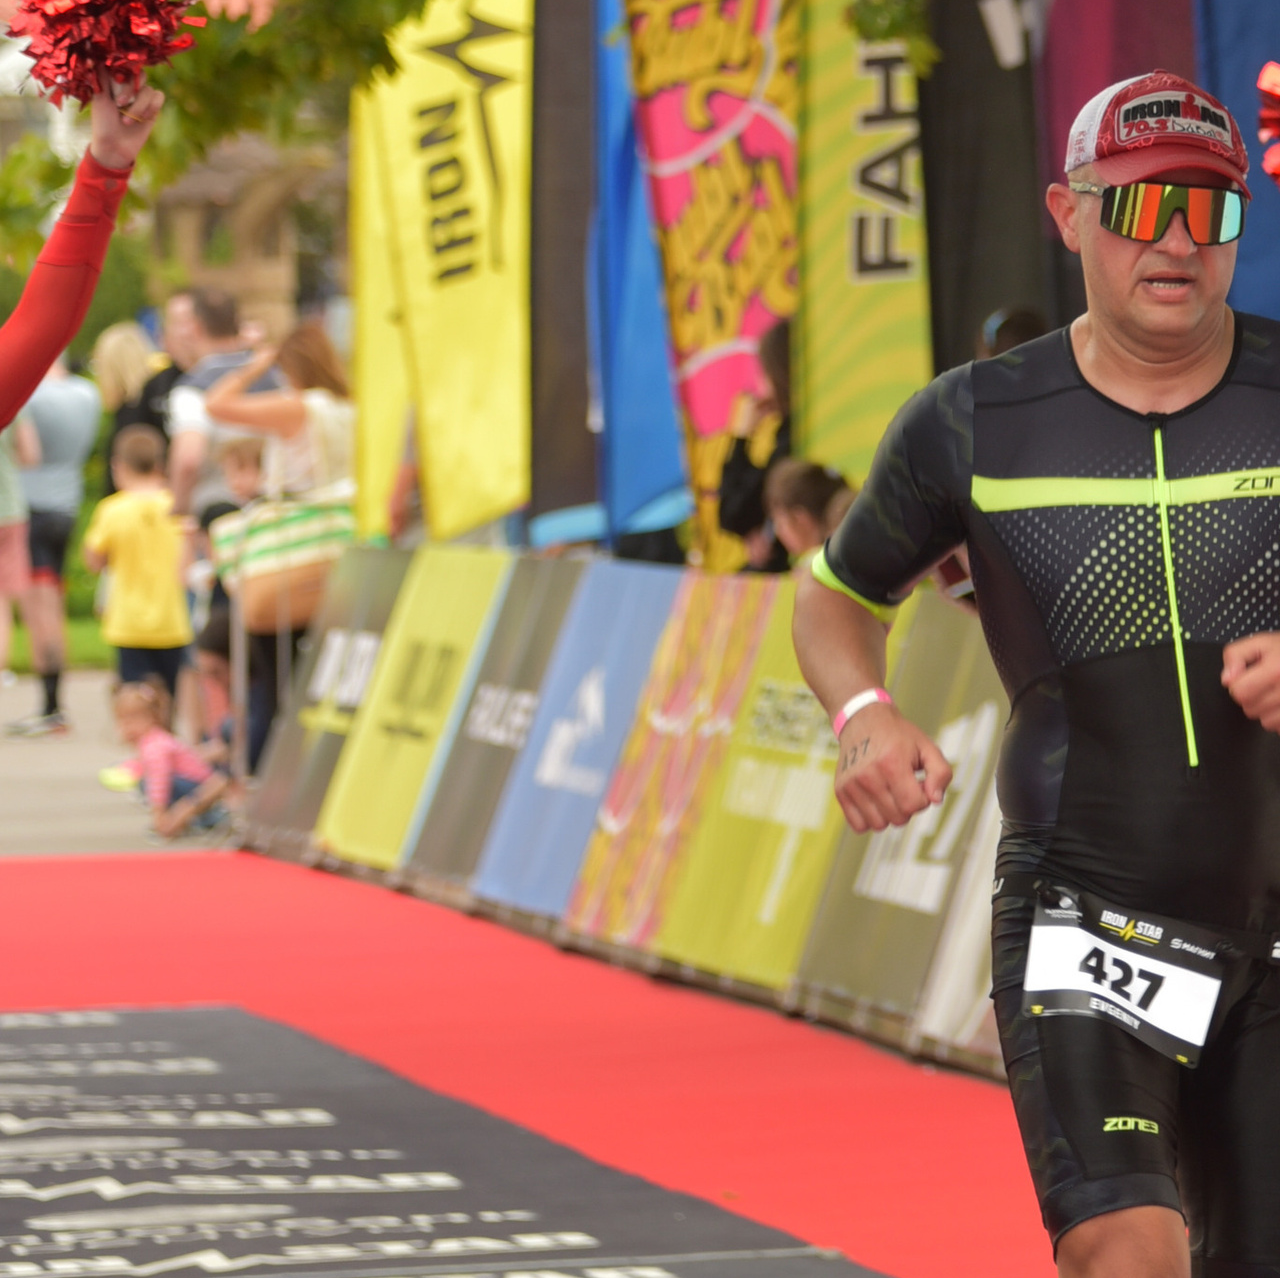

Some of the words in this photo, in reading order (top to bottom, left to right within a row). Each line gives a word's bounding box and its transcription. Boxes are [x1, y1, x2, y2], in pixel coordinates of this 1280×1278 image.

[1123, 94, 1229, 133] IRONMAN
[1123, 119, 1168, 137] 70.3
[1101, 910, 1128, 929] IRON
[1135, 921, 1164, 940] STAR
[1079, 946, 1166, 1012] 427
